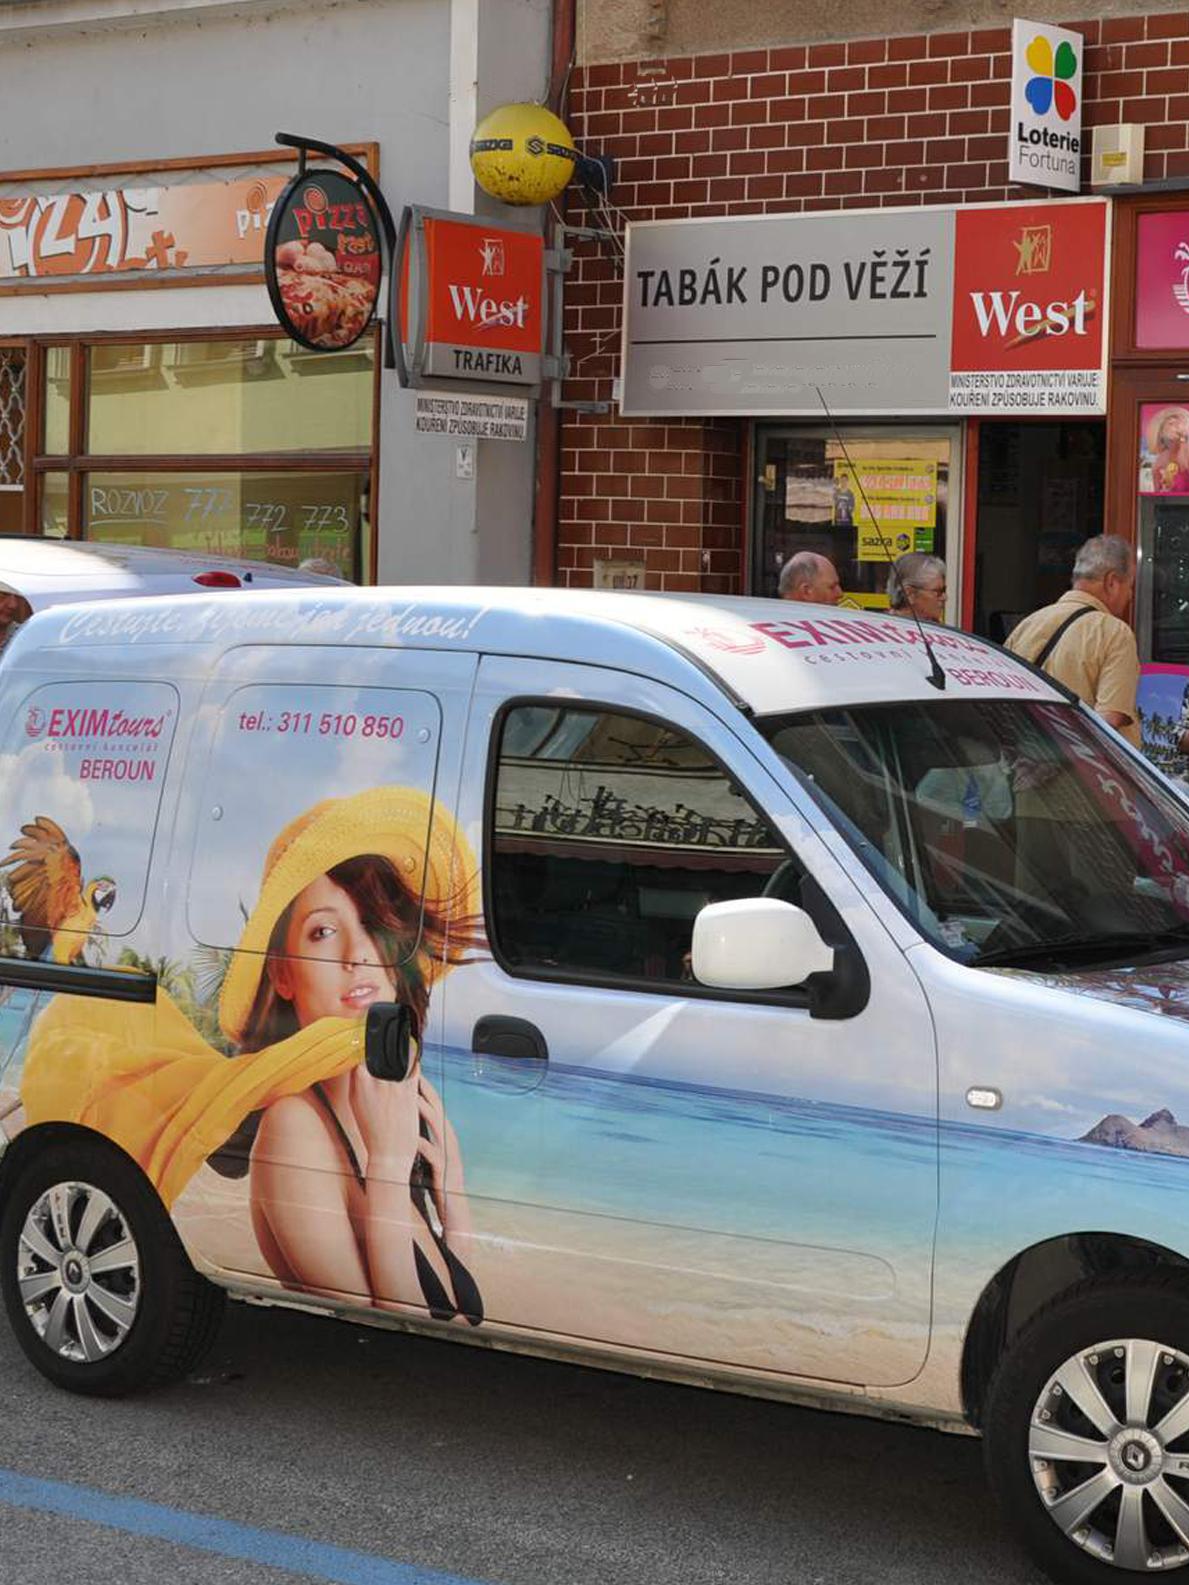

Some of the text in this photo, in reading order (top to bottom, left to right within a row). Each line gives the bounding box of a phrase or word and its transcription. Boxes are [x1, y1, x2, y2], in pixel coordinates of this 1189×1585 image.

[1018, 121, 1080, 154] Loterie
[1018, 144, 1076, 176] Fortuna
[637, 248, 931, 308] TABÁK POD VĚŽÍ
[449, 285, 528, 329] West
[970, 289, 1091, 337] West
[454, 349, 523, 376] TRAFIKA
[991, 388, 1046, 407] ZPŮSOBUJE
[91, 487, 169, 516] ROZVOZ
[247, 503, 290, 532] 772
[301, 505, 350, 532] 773
[345, 605, 491, 641] jednou!
[946, 666, 1040, 692] BEROUN
[239, 711, 404, 739] tel.: 311 510 850
[80, 759, 155, 781] BEROUN
